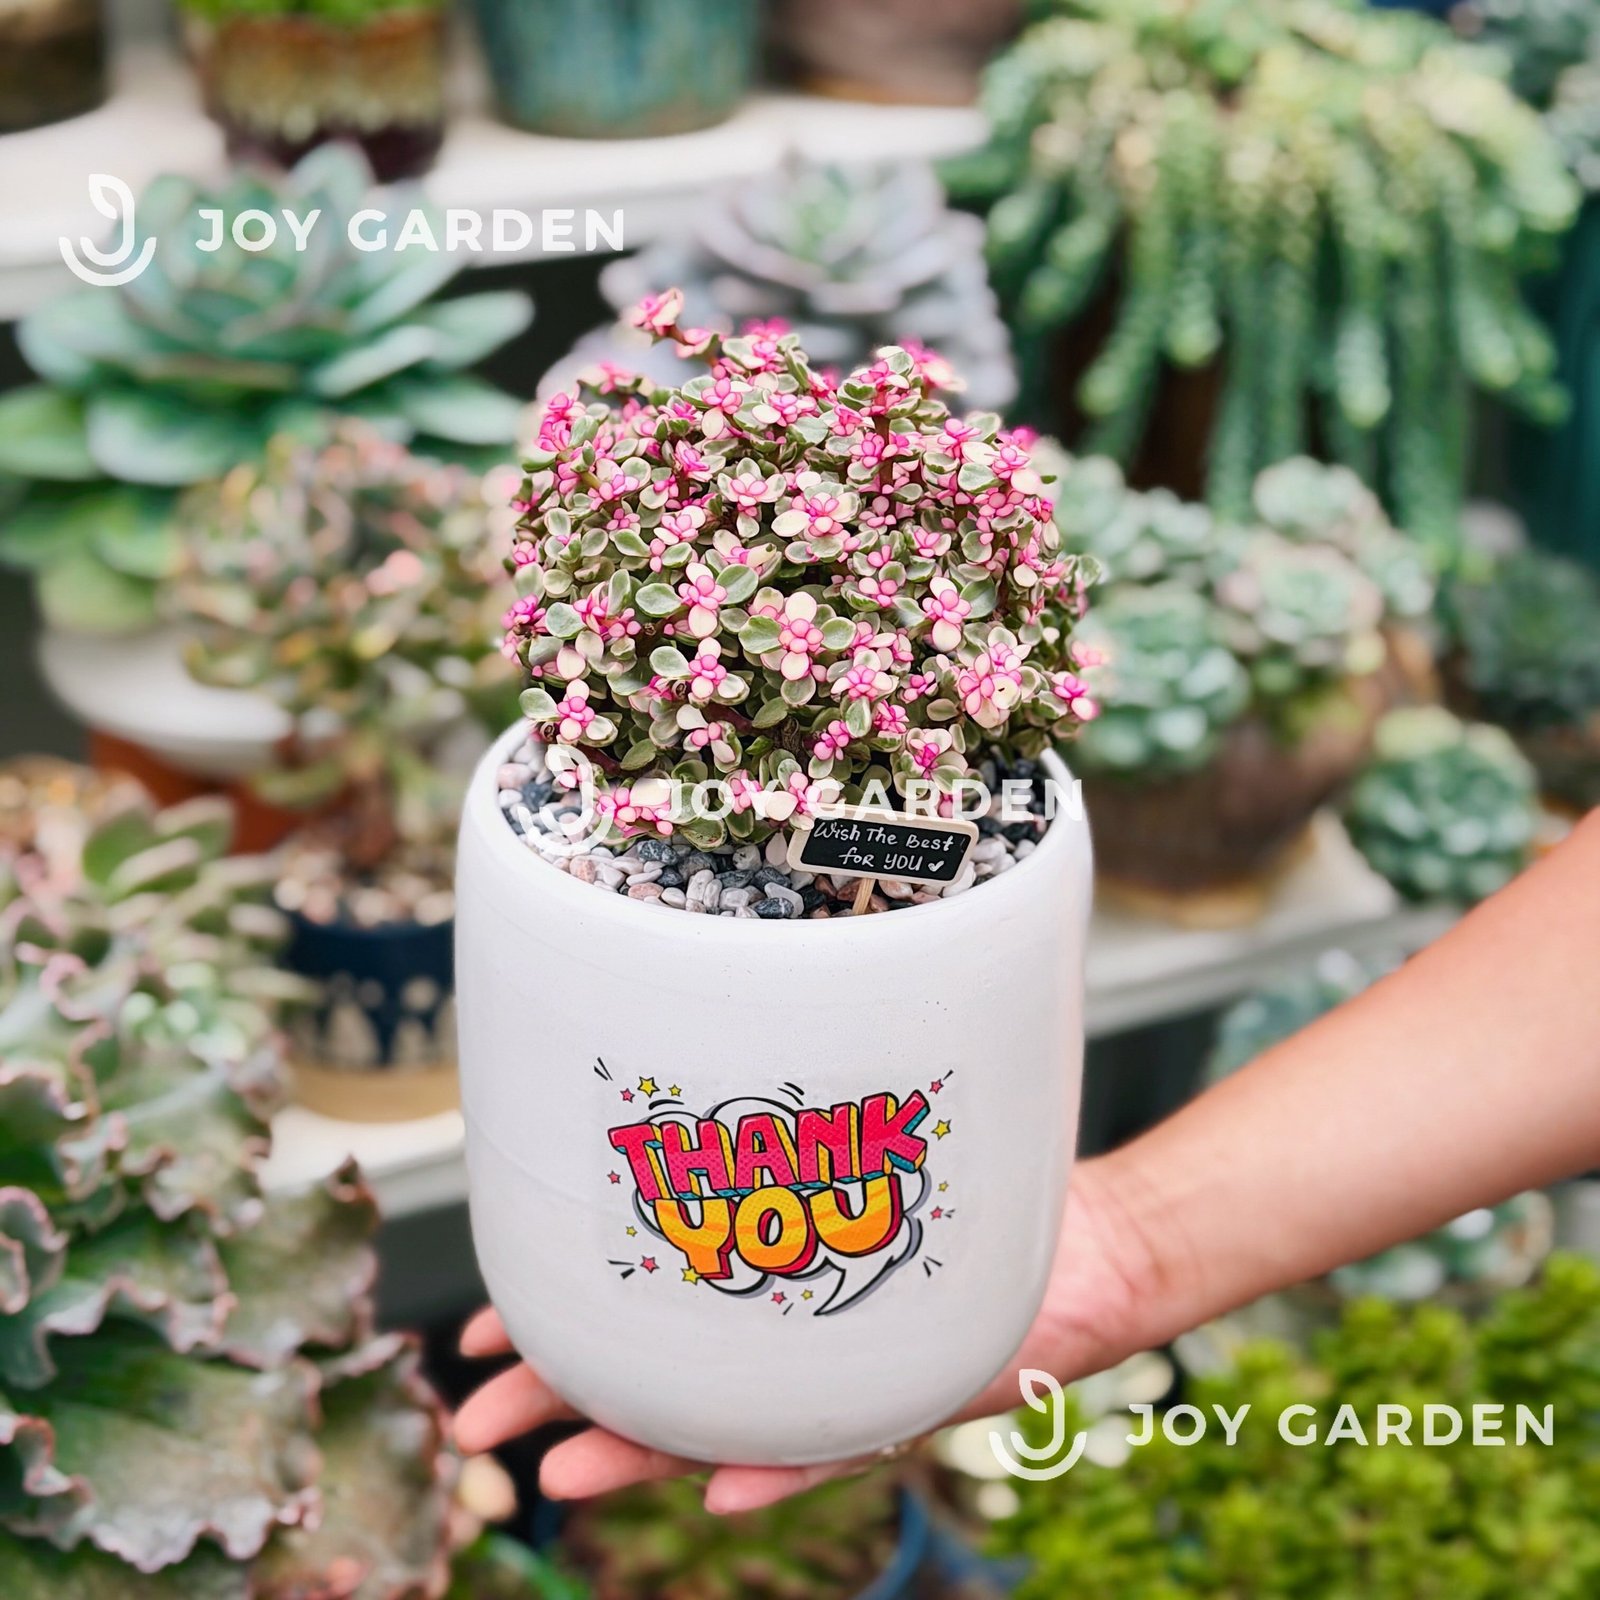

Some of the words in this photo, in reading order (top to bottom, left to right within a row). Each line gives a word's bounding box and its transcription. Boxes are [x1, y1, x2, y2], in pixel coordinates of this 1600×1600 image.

[813, 821, 861, 842] Wish
[866, 827, 898, 845] The
[905, 834, 954, 851] Best
[607, 1089, 931, 1206] THANK
[652, 1173, 904, 1279] YOU
